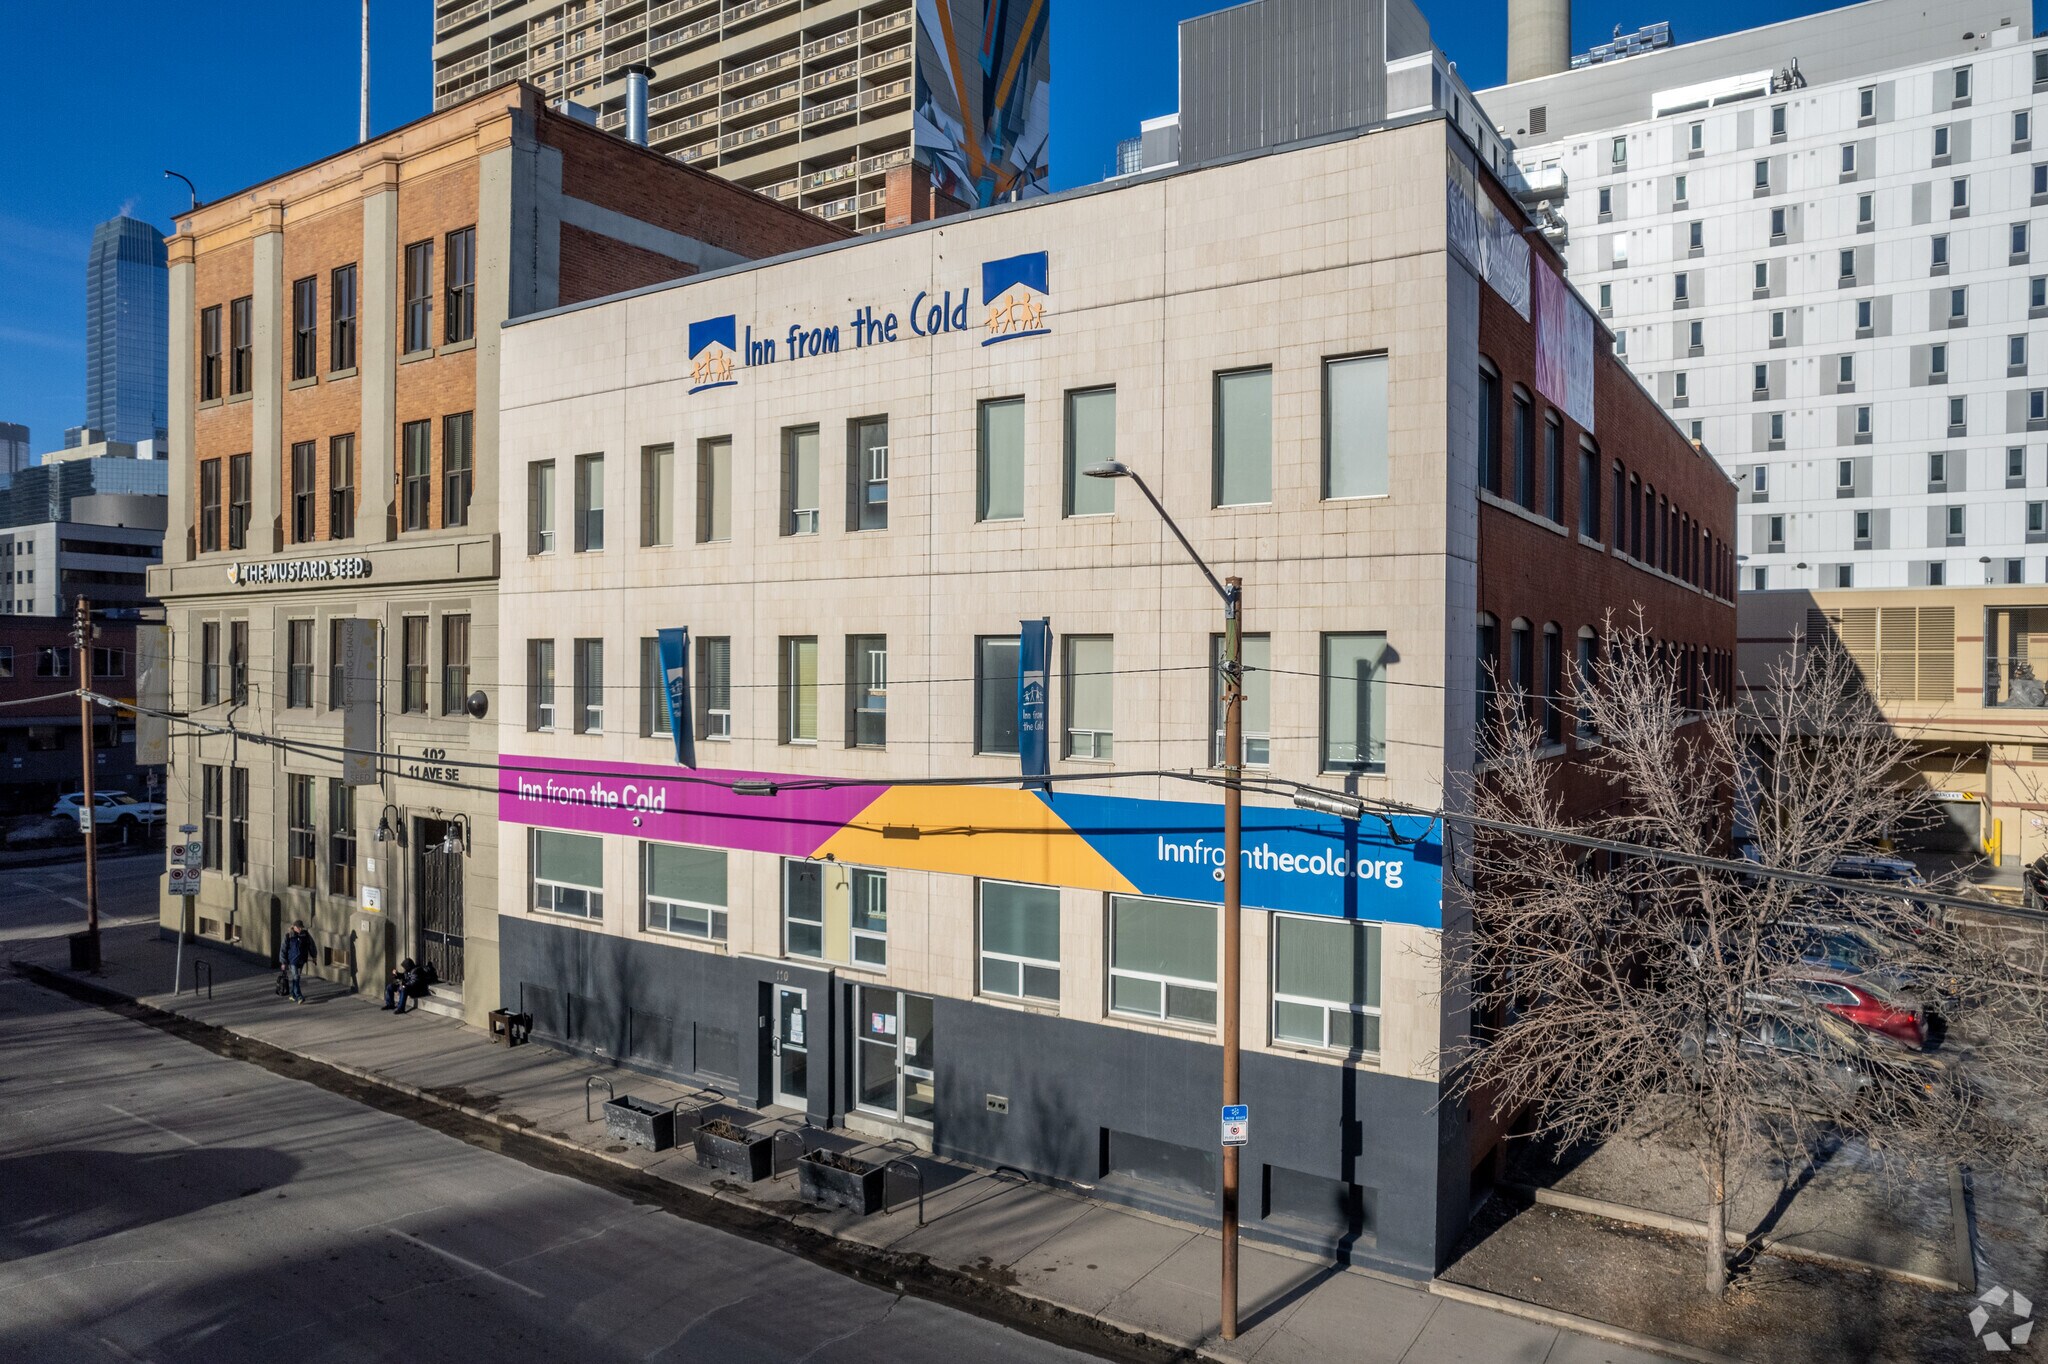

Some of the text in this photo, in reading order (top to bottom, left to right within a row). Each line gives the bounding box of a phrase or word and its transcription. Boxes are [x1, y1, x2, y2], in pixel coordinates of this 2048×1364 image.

[745, 287, 969, 366] Inn from the Cold
[243, 557, 364, 581] THE MUSTARD SEED
[346, 621, 354, 713] SUPPORTING CHANGE
[422, 748, 446, 764] 102
[409, 765, 460, 781] 11 AVE SE
[518, 776, 666, 815] Inn from the Cold
